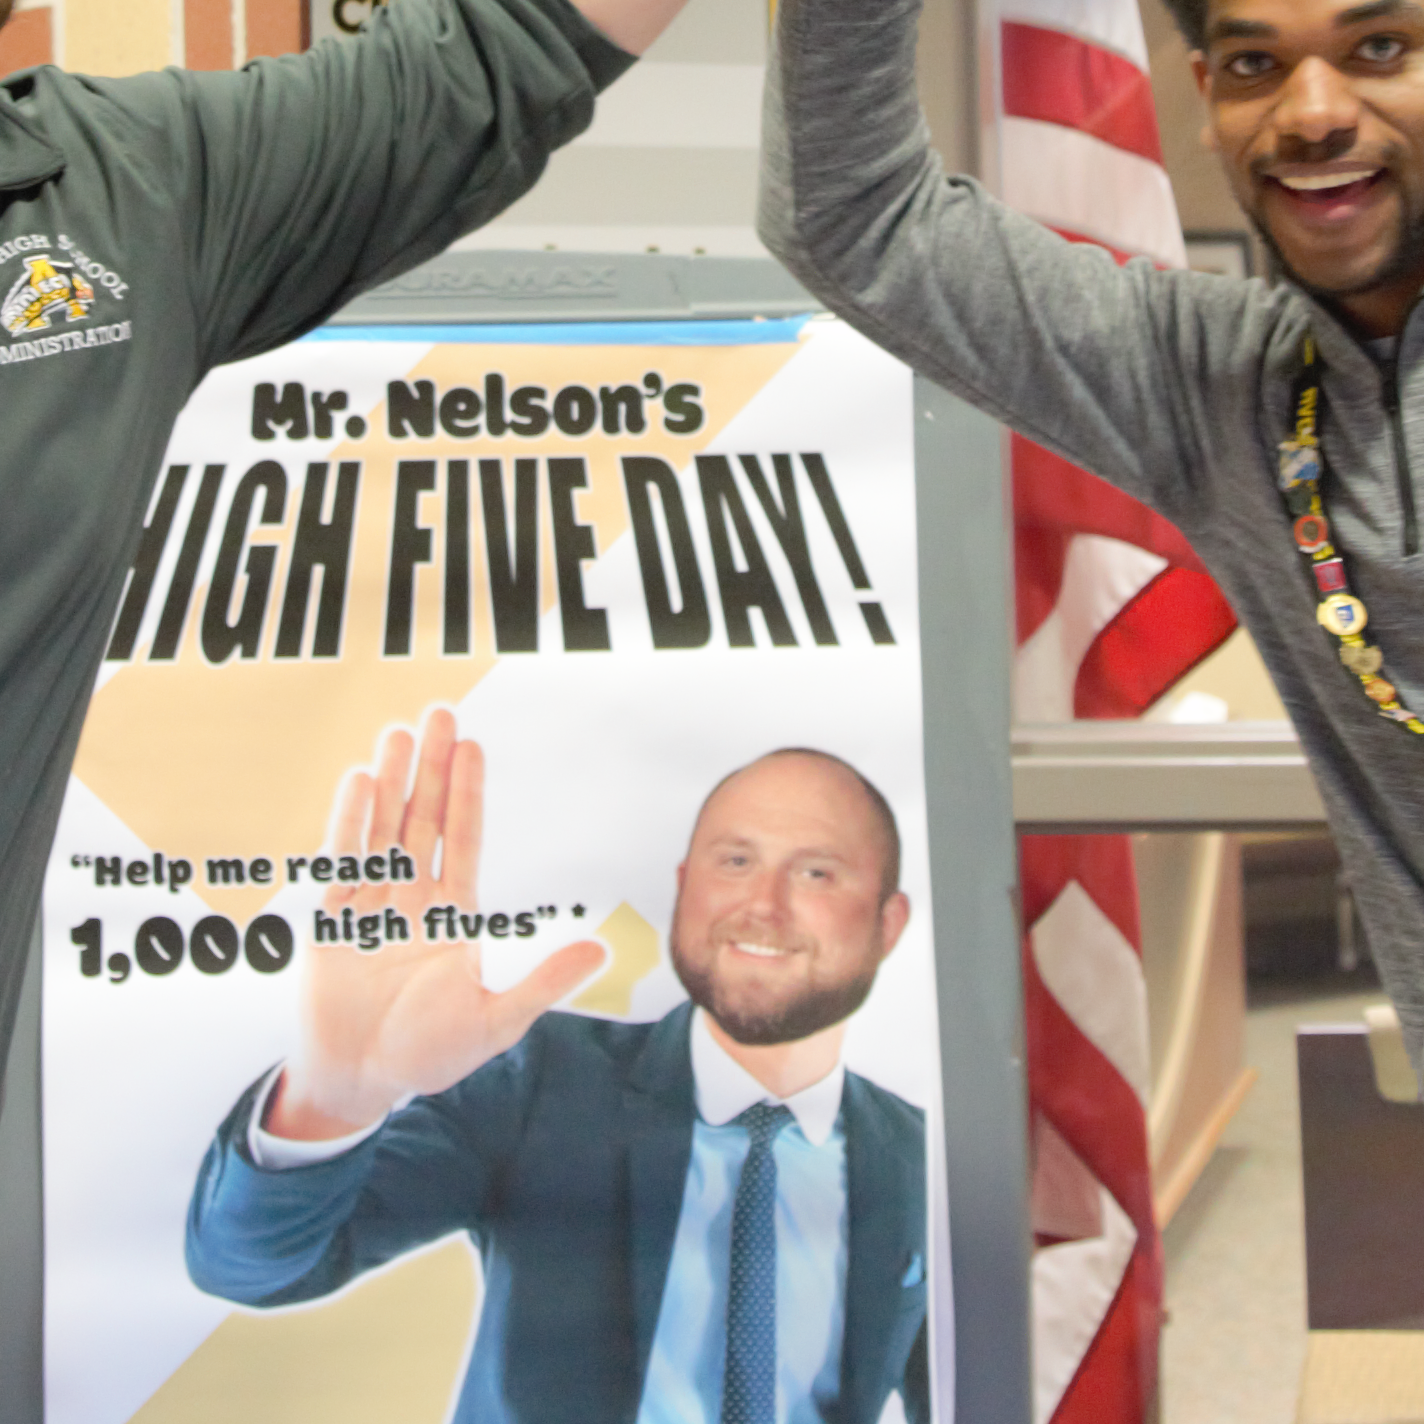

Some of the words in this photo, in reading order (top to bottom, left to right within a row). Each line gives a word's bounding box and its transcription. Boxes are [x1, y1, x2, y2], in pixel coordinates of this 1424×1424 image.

[251, 381, 367, 441] Mr.
[387, 372, 704, 438] Nelson’s
[104, 459, 362, 666] HIGH
[382, 457, 612, 656] FIVE
[620, 452, 897, 651] DAY!
[206, 856, 273, 884] me
[286, 848, 415, 883] reach
[71, 913, 294, 984] 1,000
[312, 907, 409, 950] high
